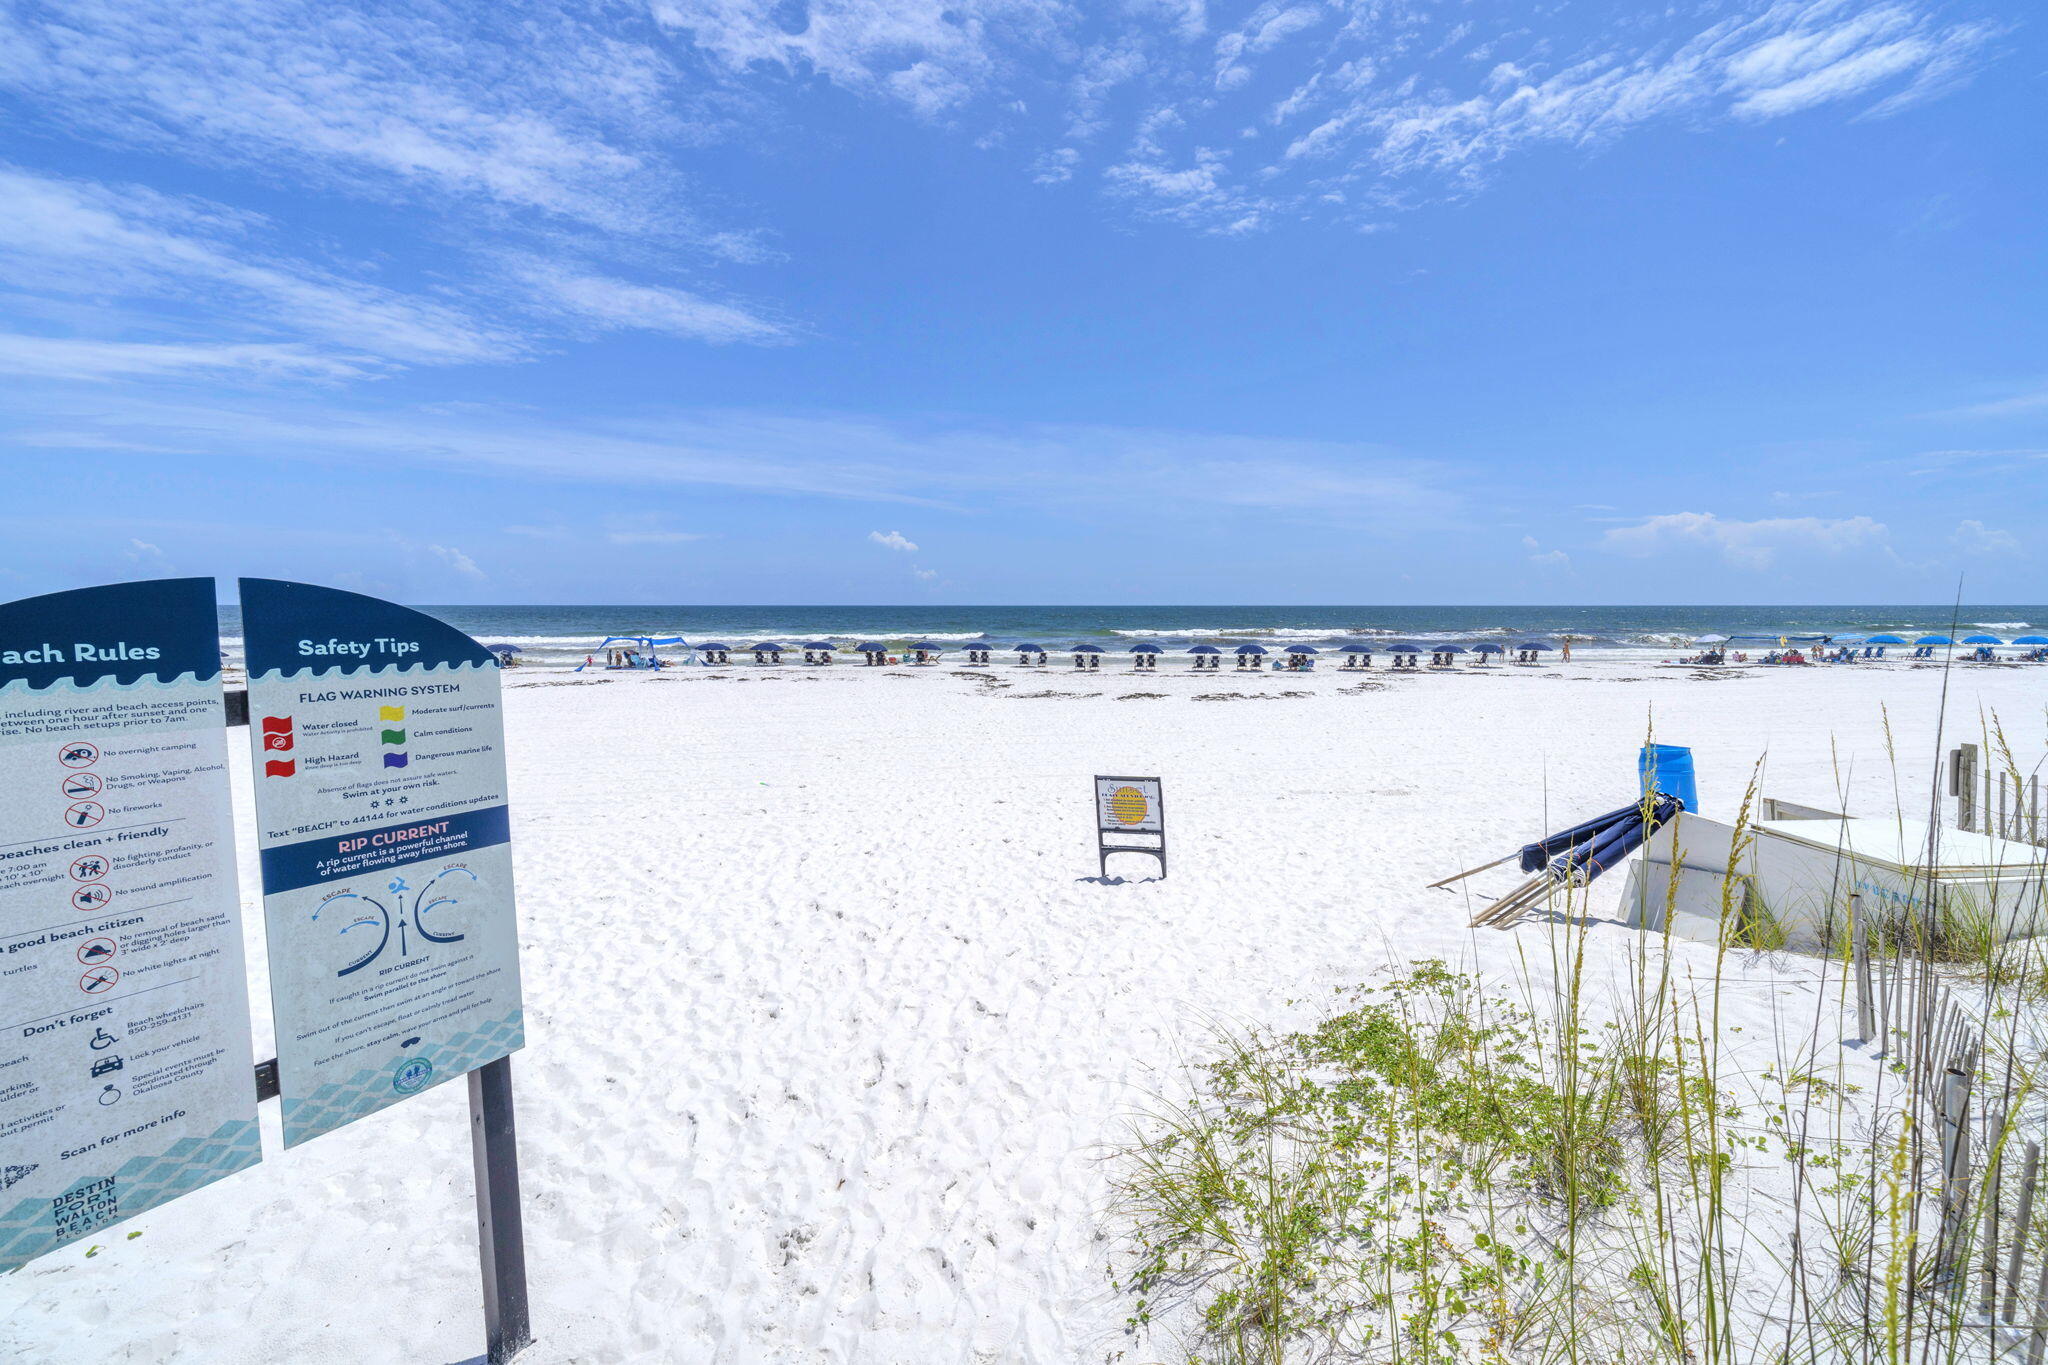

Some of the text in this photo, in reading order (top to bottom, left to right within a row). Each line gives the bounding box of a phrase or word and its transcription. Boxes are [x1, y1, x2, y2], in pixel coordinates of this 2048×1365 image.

[2, 641, 161, 664] ach Rules
[298, 638, 420, 659] Safety Tips
[300, 684, 460, 703] FLAG WARNING SYSTEM
[1, 718, 44, 727] etween
[73, 714, 99, 722] hour
[102, 712, 128, 720] after
[131, 709, 167, 718] sunset
[168, 707, 187, 715] and
[5, 708, 61, 718] including
[65, 707, 89, 715] river
[92, 704, 113, 713] and
[117, 702, 148, 711] beach
[186, 699, 219, 709] points,
[412, 702, 495, 715] Moderate surf/currents
[46, 722, 80, 732] beach
[83, 721, 120, 729] setups
[124, 718, 148, 728] prior
[302, 720, 358, 731] Water closed
[435, 727, 472, 735] conditions
[118, 746, 159, 755] overnight
[304, 752, 359, 764] High Hazard
[415, 751, 454, 761] Dangerous
[121, 772, 160, 781] Smoking,
[162, 768, 192, 776] Vaping,
[194, 763, 225, 772] Alcohol,
[106, 782, 135, 790] Drugs,
[148, 776, 186, 785] Weapons
[343, 791, 368, 799] Swim
[382, 786, 401, 795] your
[423, 779, 440, 787] risk.
[123, 802, 162, 812] fireworks
[268, 829, 289, 838] Text
[353, 813, 384, 824] 44144
[400, 807, 424, 816] water
[426, 799, 467, 811] conditions
[469, 794, 499, 805] updates
[63, 838, 102, 850] clean
[117, 827, 169, 842] friendly
[338, 821, 449, 853] RIP CURRENT
[342, 850, 377, 863] current
[396, 838, 433, 853] powerful
[435, 831, 468, 844] channel
[113, 851, 191, 870] disorderly conduct
[127, 851, 162, 861] fighting,
[165, 844, 204, 855] profanity,
[320, 841, 467, 876] of water flowing away from shore.
[8, 864, 30, 873] 7:00
[443, 863, 467, 871] ESCAPE
[23, 873, 64, 886] overnight
[130, 882, 157, 893] sound
[159, 873, 213, 887] amplification
[322, 888, 351, 902] ESCAPE
[8, 918, 144, 951] good beach citizen
[131, 935, 162, 946] digging
[164, 929, 186, 938] holes
[188, 924, 210, 933] larger
[212, 919, 231, 927] than
[134, 925, 168, 938] removal
[180, 918, 204, 928] beach
[206, 913, 225, 922] sand
[3, 964, 38, 976] turtles
[137, 963, 161, 973] white
[163, 957, 187, 967] lights
[189, 953, 197, 961] at
[199, 948, 220, 958] night
[379, 956, 430, 976] RIP CURRENT
[364, 992, 383, 1002] Swim
[384, 981, 409, 996] parallel
[430, 970, 447, 979] shore
[24, 1005, 113, 1037] Don't forget
[127, 1002, 205, 1028] Beach wheelchairs
[128, 1010, 192, 1036] 850-259-4131
[130, 1034, 200, 1061] Lock your vehicle
[132, 1067, 163, 1082] Special
[165, 1059, 191, 1071] events
[193, 1051, 214, 1062] must
[132, 1056, 217, 1089] coordinated through
[133, 1069, 204, 1096] Okaloosa County
[7, 1109, 53, 1128] activities
[21, 1115, 54, 1132] permit
[61, 1110, 186, 1160] Scan for more info
[53, 1176, 116, 1208] DESTIN
[54, 1187, 115, 1218] FORT
[56, 1196, 117, 1227] WALTON
[56, 1205, 118, 1237] BEACH
[56, 1215, 118, 1242] FLORIDA
